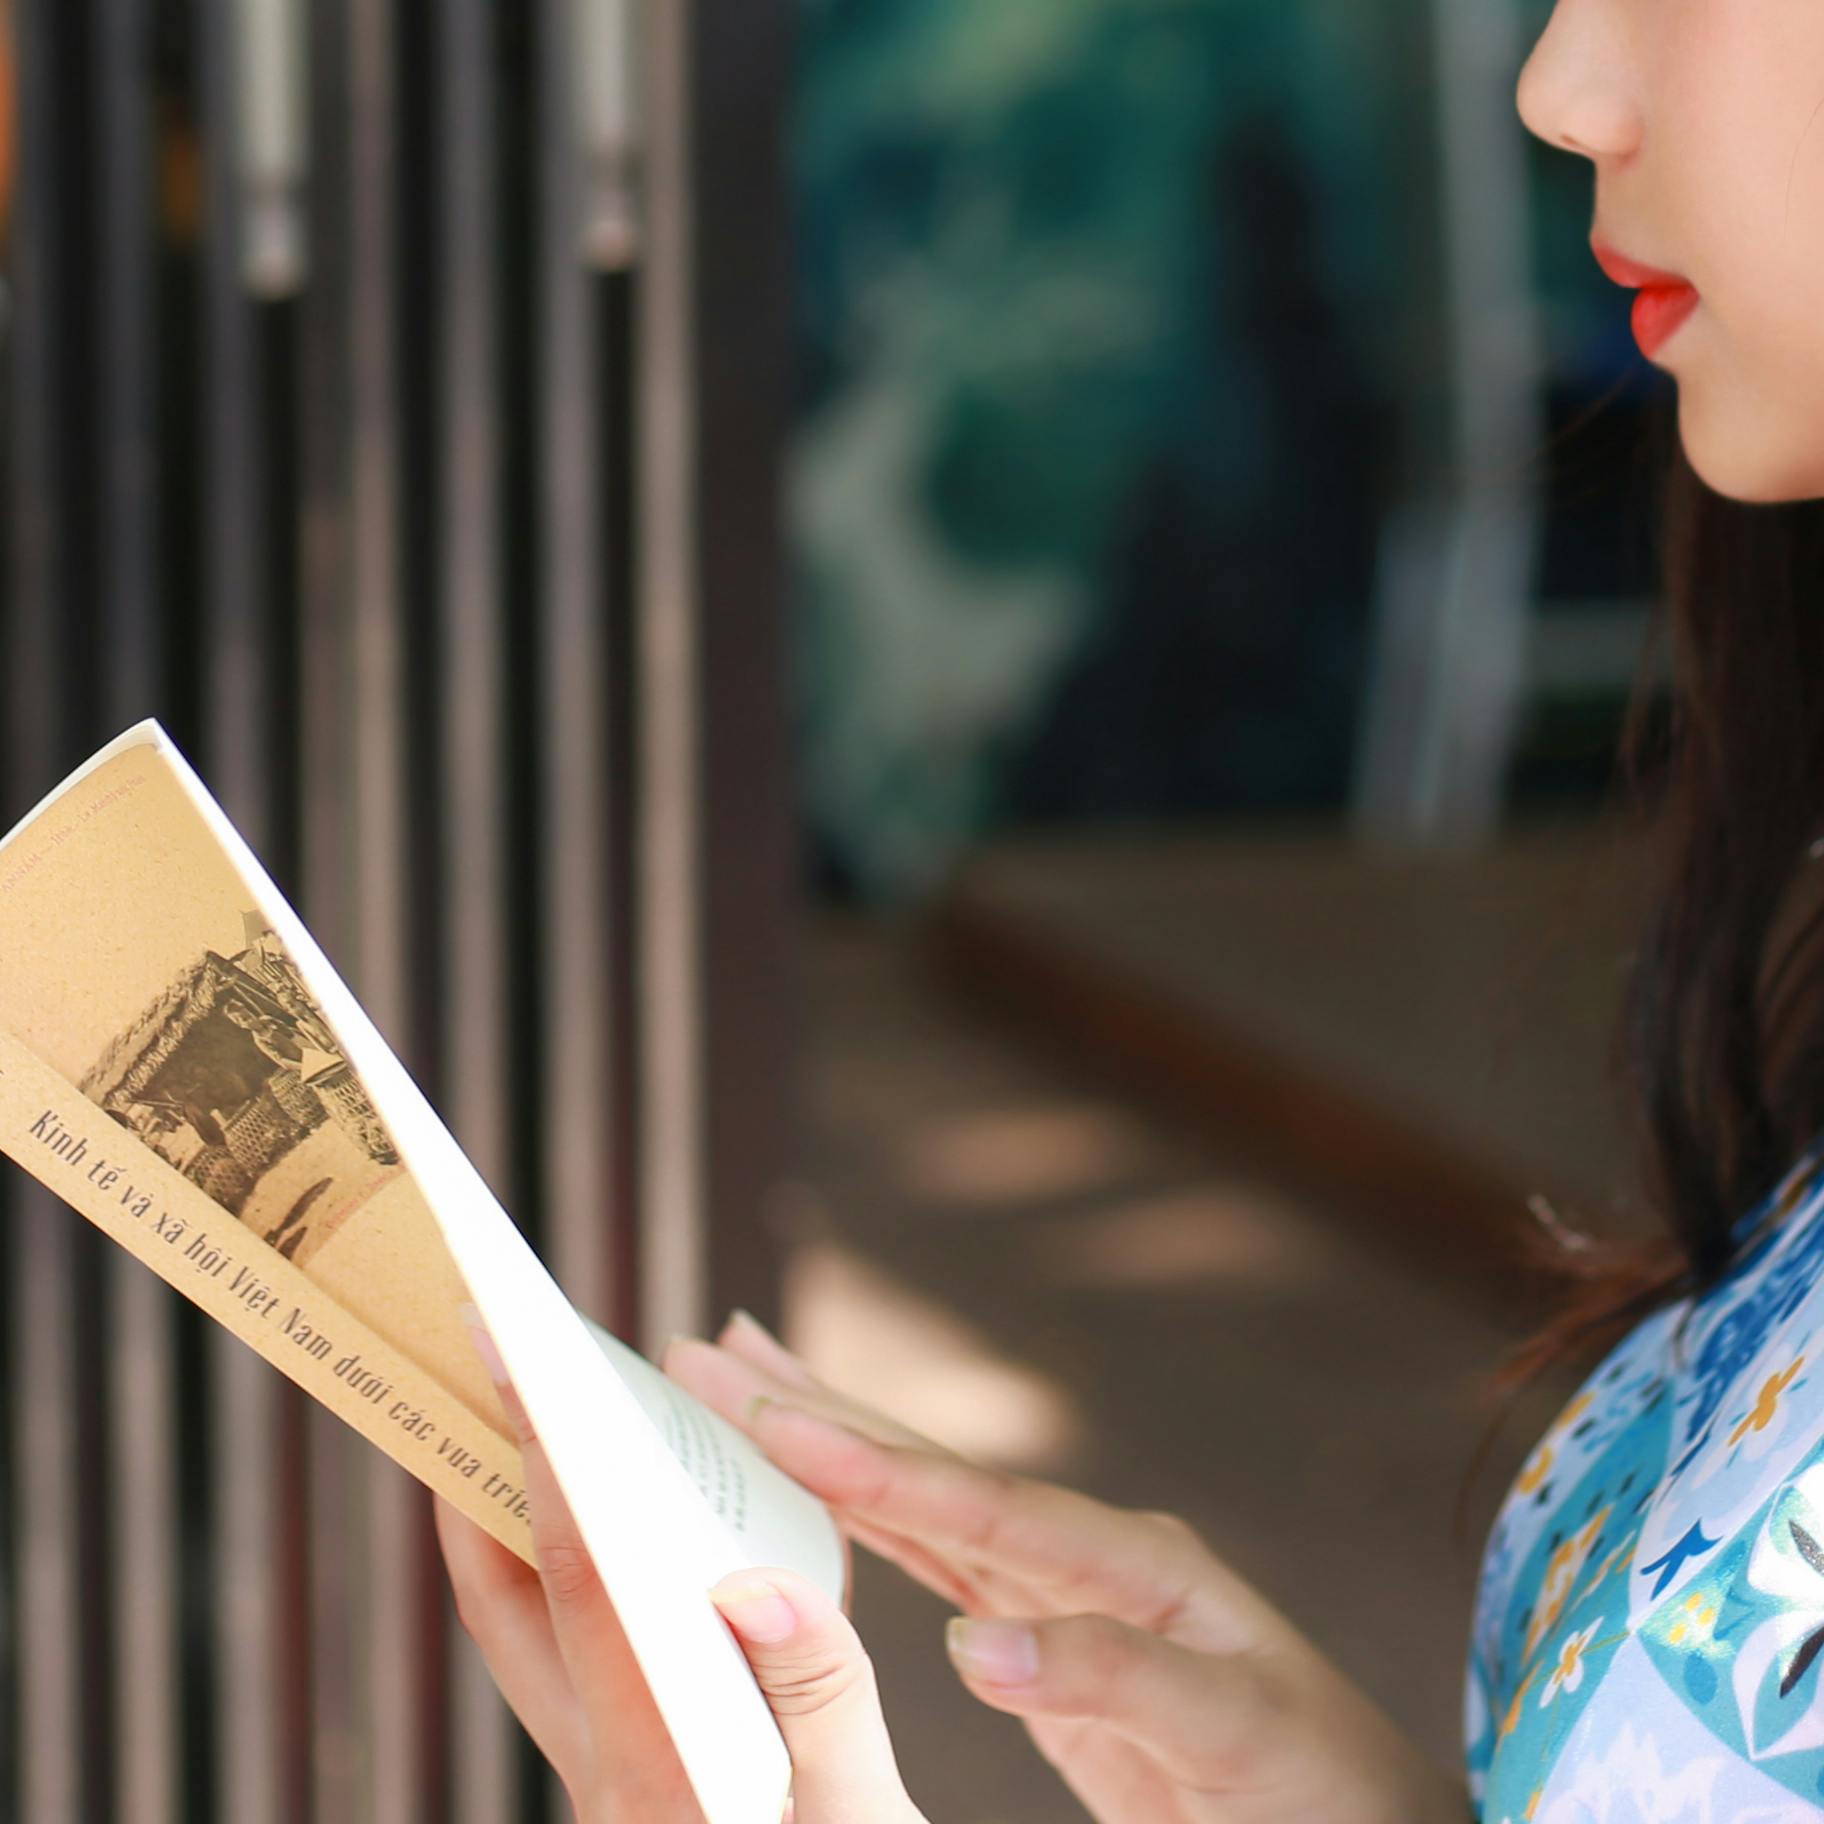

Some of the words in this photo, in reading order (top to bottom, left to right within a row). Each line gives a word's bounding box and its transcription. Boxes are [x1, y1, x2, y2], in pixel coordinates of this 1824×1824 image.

[29, 1109, 88, 1167] Kinh
[87, 1159, 128, 1191] tế
[120, 1185, 155, 1218] và
[153, 1212, 190, 1244] xã
[183, 1233, 234, 1278] hội
[228, 1265, 280, 1320] Việt
[278, 1307, 334, 1361] Nam
[332, 1355, 394, 1405] dưới
[387, 1401, 437, 1442] các
[436, 1437, 483, 1479] vua
